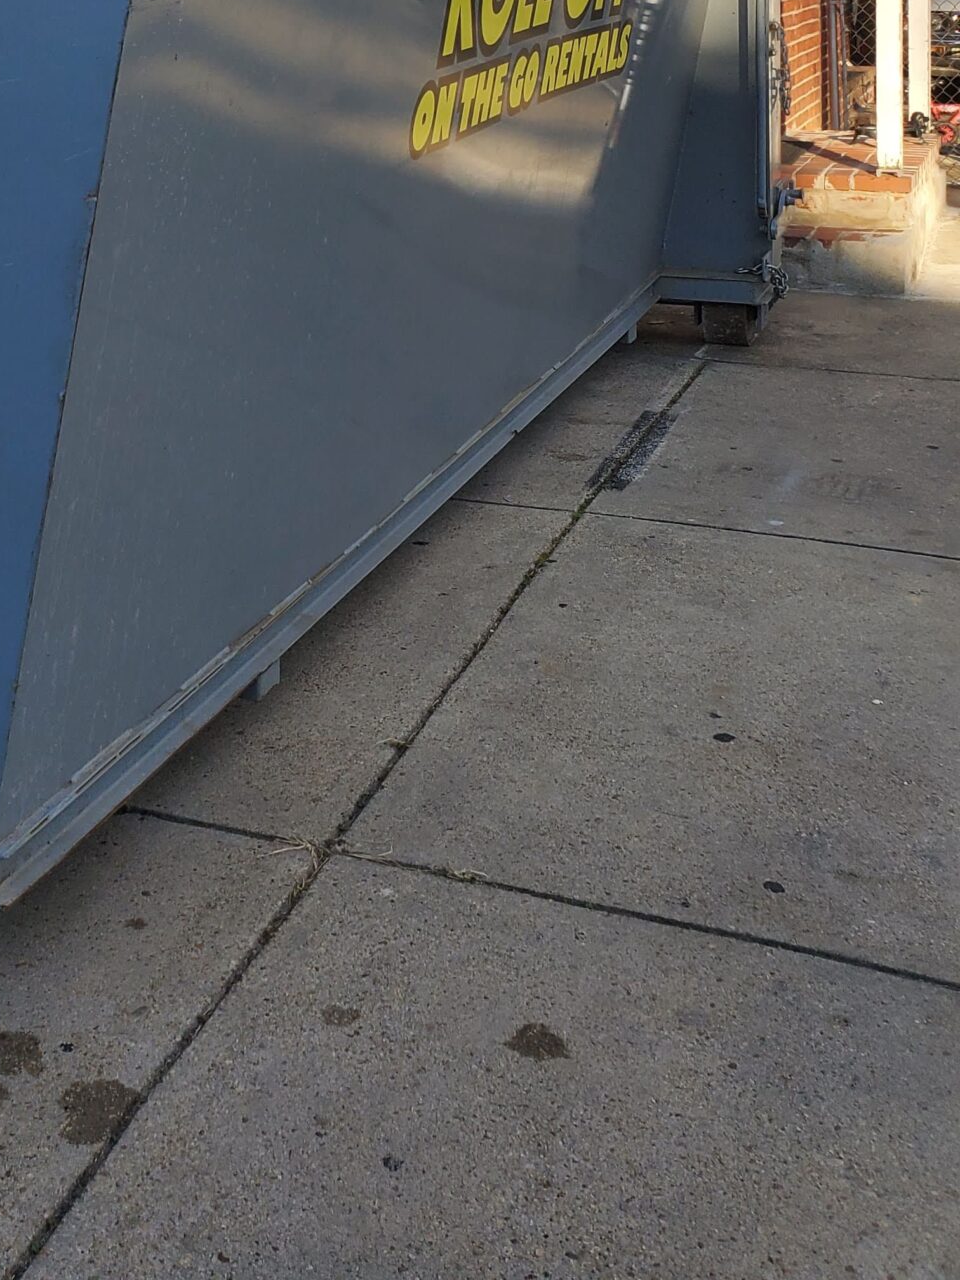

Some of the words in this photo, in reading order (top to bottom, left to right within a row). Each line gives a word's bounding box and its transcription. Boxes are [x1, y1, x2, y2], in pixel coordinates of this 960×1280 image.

[410, 77, 459, 155] ON
[458, 59, 510, 136] THE
[508, 48, 540, 111] GO
[539, 23, 632, 97] RENTALS
